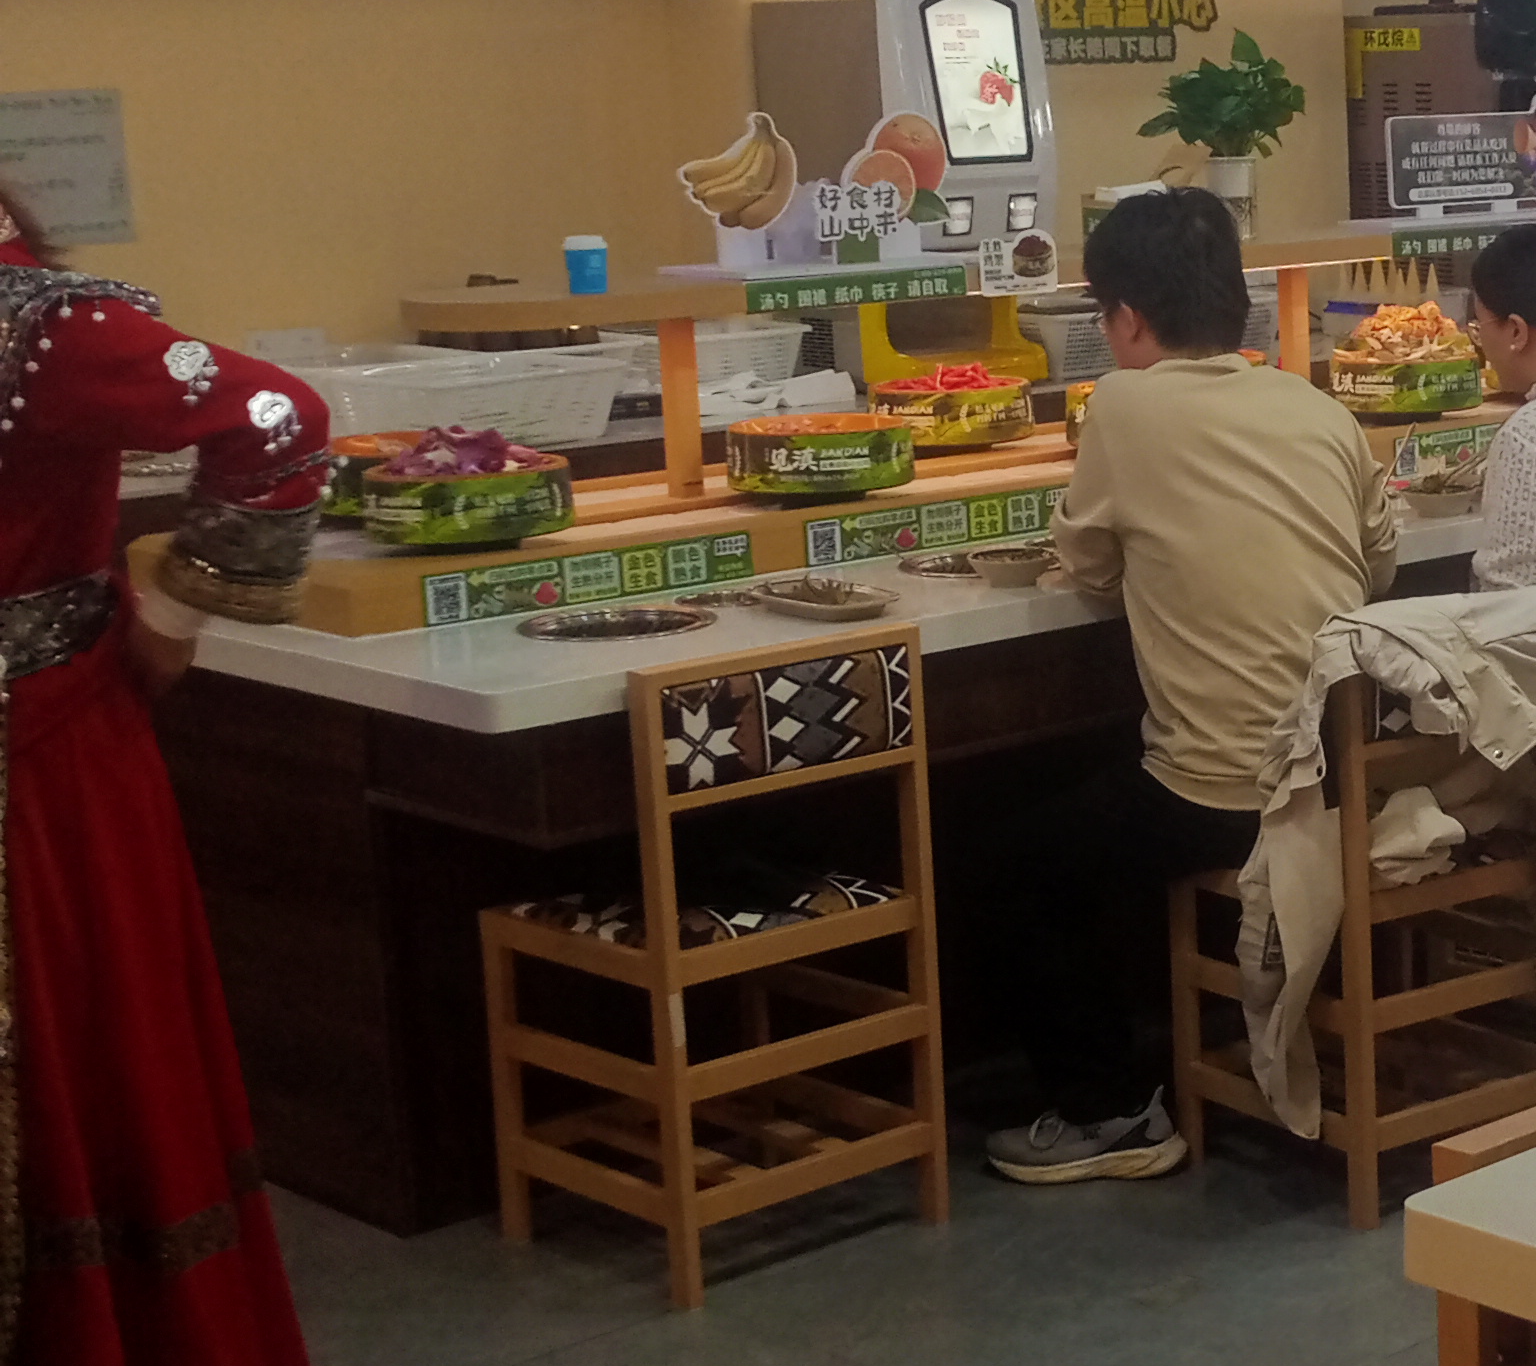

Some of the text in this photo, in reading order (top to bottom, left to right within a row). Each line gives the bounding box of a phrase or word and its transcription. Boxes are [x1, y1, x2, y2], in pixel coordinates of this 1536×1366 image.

[818, 185, 896, 210] 好食材
[820, 213, 897, 238] 山中来
[760, 292, 789, 311] 汤勺
[834, 286, 864, 304] 纸巾
[871, 282, 900, 301] 筷子
[907, 278, 949, 297] 请自取
[769, 447, 819, 472] 见滇
[820, 446, 870, 458] JIANDIAN
[974, 502, 998, 518] 金色
[974, 517, 999, 534] 生食
